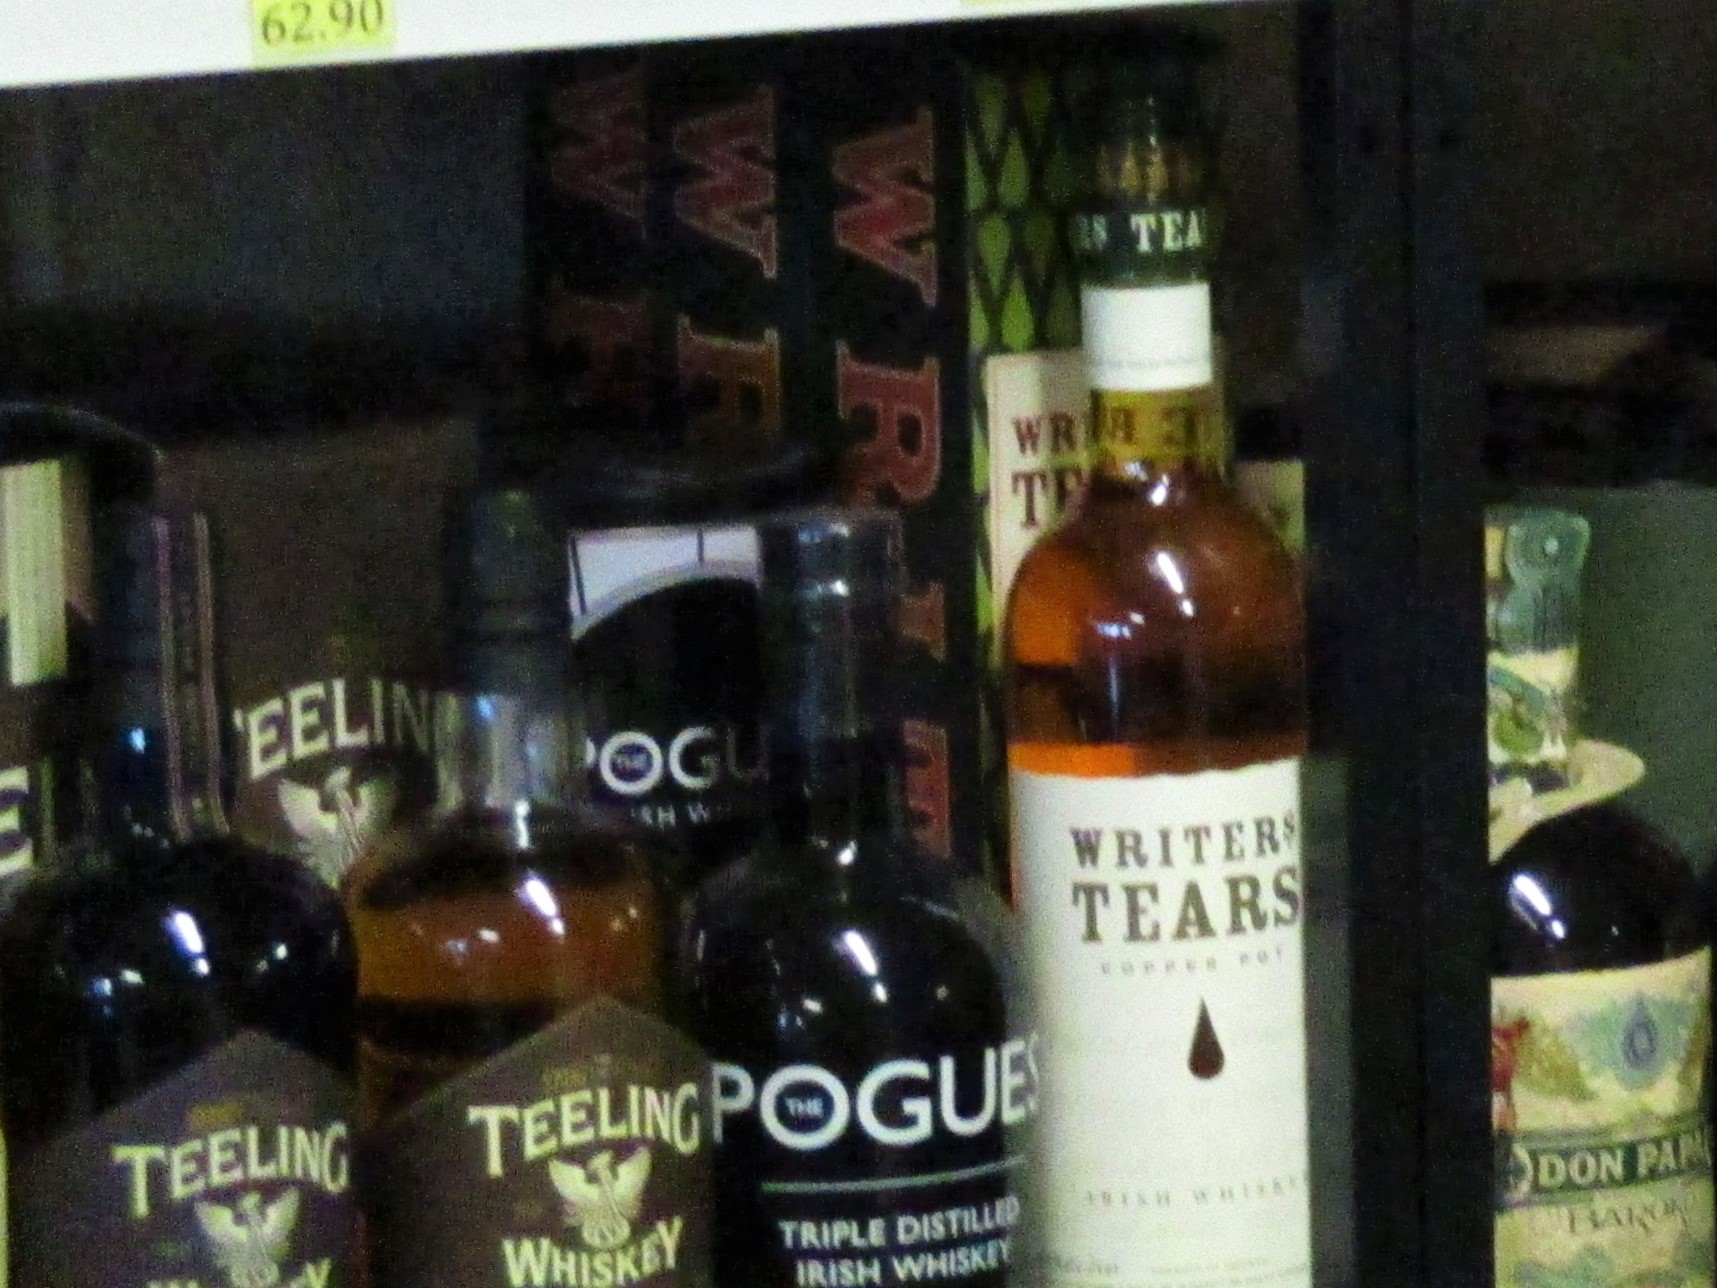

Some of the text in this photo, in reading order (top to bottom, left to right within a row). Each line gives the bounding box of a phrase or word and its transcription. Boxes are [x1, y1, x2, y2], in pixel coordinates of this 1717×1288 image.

[1072, 866, 1301, 946] TEARS
[467, 1082, 699, 1179] TEELING
[112, 1121, 350, 1220] TEELING
[1537, 1148, 1626, 1191] DON
[501, 1215, 685, 1288] WHISKEY
[779, 1217, 888, 1250] TRIPLE
[797, 1255, 883, 1287] IRISH
